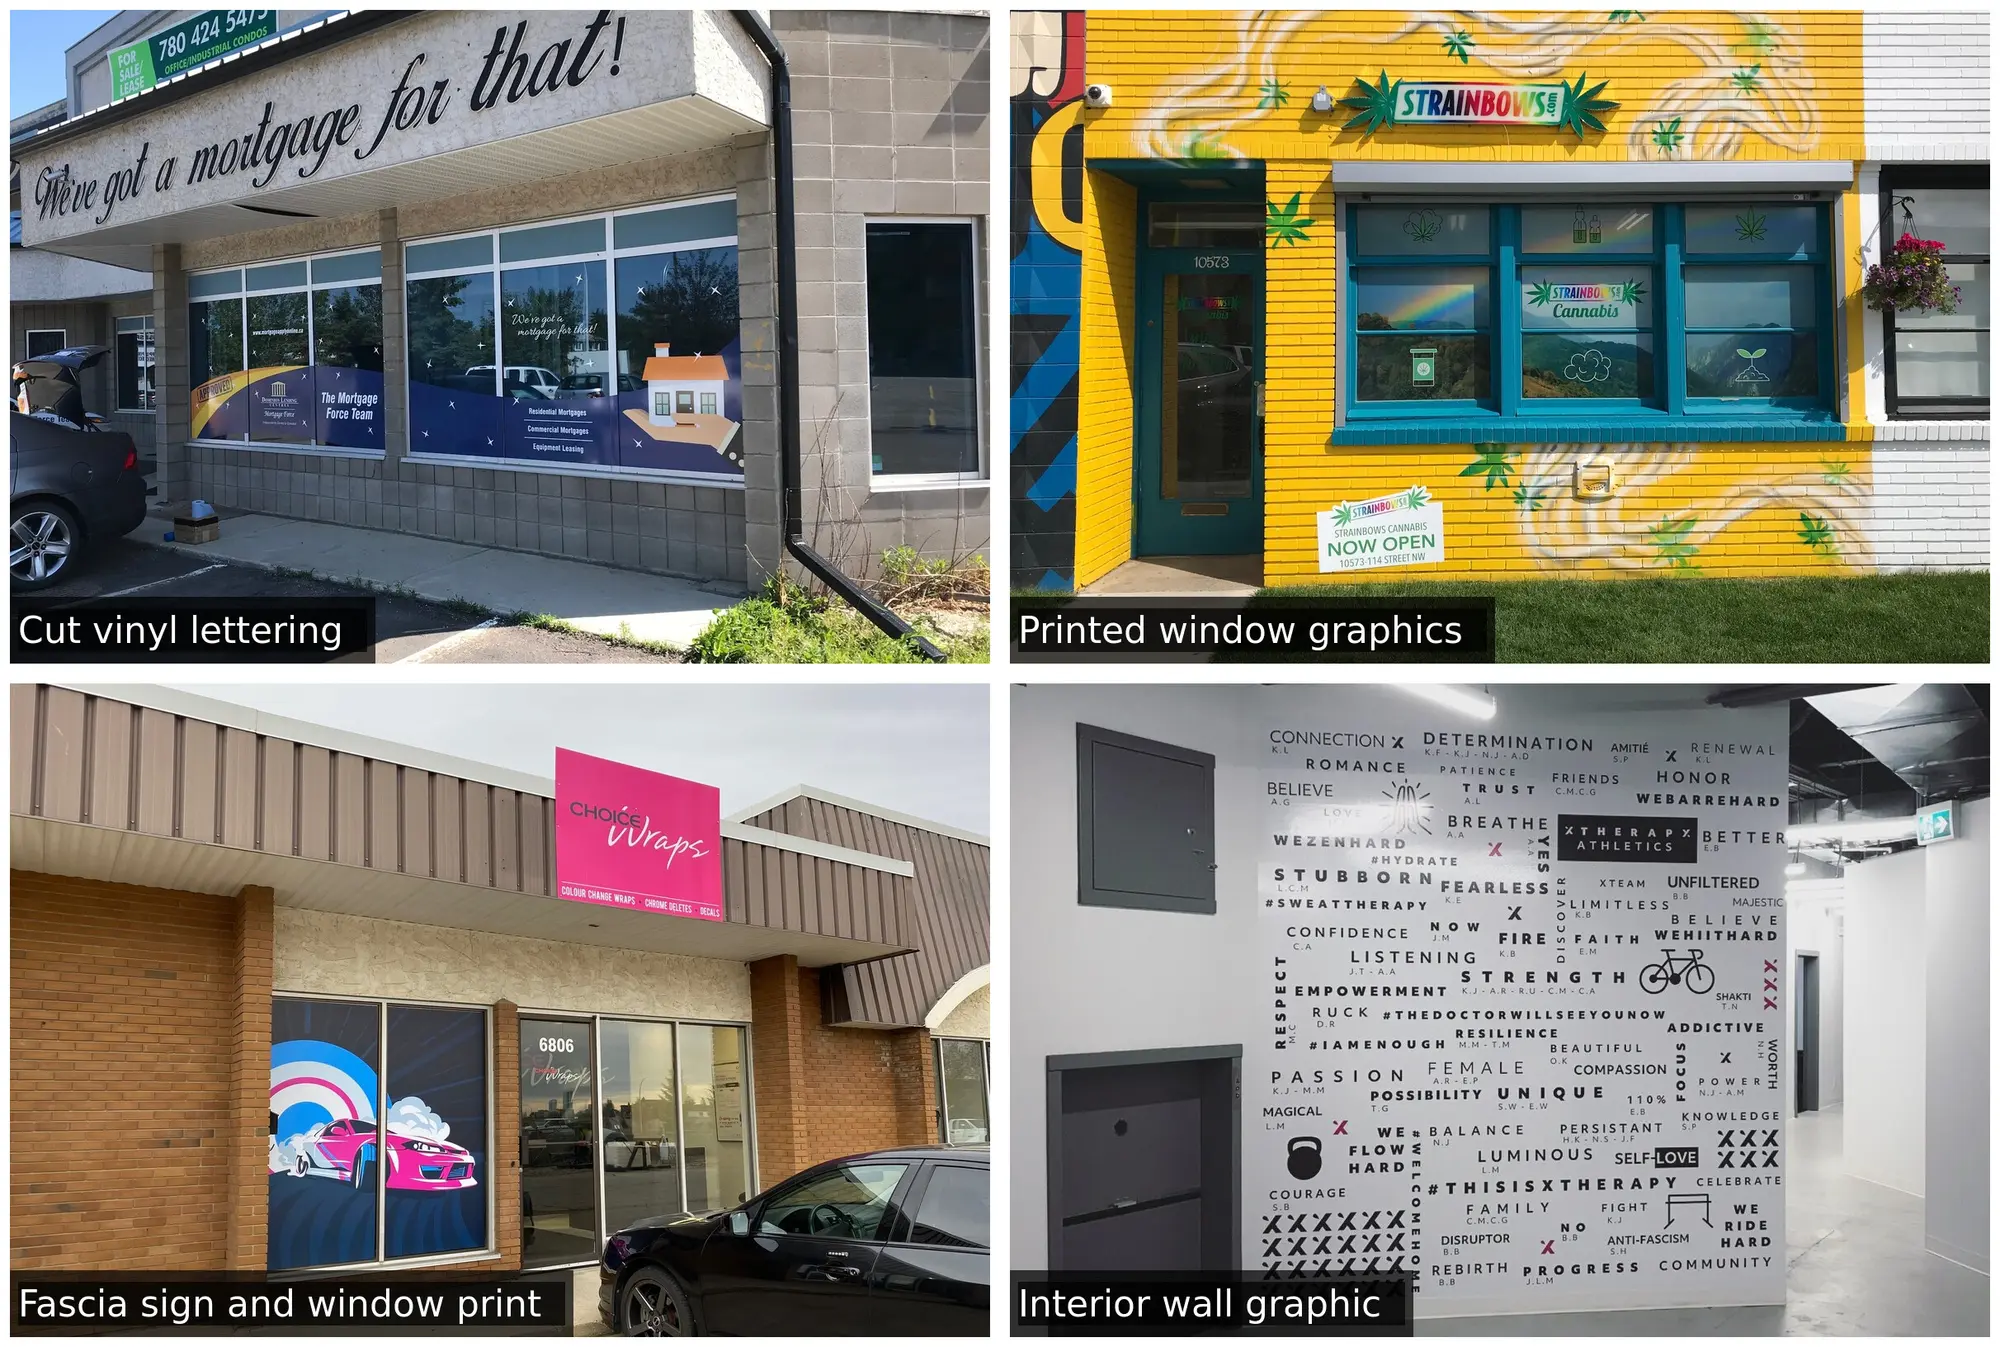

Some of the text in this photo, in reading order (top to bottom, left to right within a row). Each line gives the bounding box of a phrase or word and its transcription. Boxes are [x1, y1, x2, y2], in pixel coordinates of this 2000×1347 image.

[158, 31, 186, 62] 780
[191, 15, 220, 46] 424
[164, 26, 268, 75] OFFICE/INDUSTRIAL CONDOS
[118, 50, 137, 69] FOR
[119, 60, 144, 83] SALE/
[119, 76, 145, 97] LEASE
[1402, 88, 1546, 118] STRAINBOWS
[95, 142, 149, 224] got
[156, 157, 178, 193] a
[187, 101, 362, 188] mortgage
[354, 52, 450, 160] for
[470, 10, 626, 112] that!
[1194, 256, 1230, 268] 10573
[1553, 303, 1618, 318] Cannabis
[512, 313, 563, 328] We've got a
[517, 322, 598, 341] mortgage for that!
[199, 379, 231, 400] APPROVED
[321, 391, 378, 407] The Mortgage
[326, 407, 373, 420] Force Team
[528, 407, 587, 417] Residential Mortgages
[527, 425, 589, 435] Commercial Mortgages
[532, 443, 584, 454] Equipment Leasing
[1334, 521, 1428, 539] STRAINBOWS CANNABIS
[1328, 534, 1436, 557] NOW OPEN
[1340, 552, 1426, 568] 10573-114 STREET NW
[1269, 729, 1385, 748] CONNECTION
[1423, 731, 1594, 752] DETERMINATION
[1611, 742, 1649, 753] AMITIÉ
[1692, 743, 1775, 755] RENEWAL
[1306, 758, 1405, 773] ROMANCE
[1440, 766, 1515, 776] PATIENCE
[1553, 773, 1618, 784] FRIENDS
[1657, 771, 1730, 784] HONOR
[1268, 782, 1333, 797] BELIEVE
[1463, 783, 1534, 794] TRUST
[1637, 793, 1779, 807] WEBARREHARD
[570, 801, 641, 828] CHOICE
[1448, 815, 1547, 830] BREATHE
[608, 807, 710, 870] Wraps
[1274, 835, 1405, 849] WEZENHARD
[1703, 831, 1784, 844] BETTER
[1577, 840, 1673, 852] ATHLETICS
[1538, 836, 1549, 872] YES
[1371, 856, 1457, 866] #HYDRATE
[1275, 868, 1431, 884] STUBBORN
[1441, 881, 1548, 894] FEARLESS
[1600, 879, 1645, 887] XTEAM
[1668, 876, 1759, 889] UNFILTERED
[561, 885, 720, 918] COLOUR CHANGE WRAPS CHROME DELETES DECALS
[1266, 899, 1427, 910] #SWEATTHERAPY
[1570, 900, 1668, 910] LIMITLESS
[1733, 898, 1783, 907] MAJESTIC
[1557, 878, 1565, 963] DISCOVER
[1672, 914, 1777, 925] BELIEVE
[1287, 927, 1408, 939] CONFIDENCE
[1431, 922, 1480, 932] NOW
[1499, 933, 1545, 945] FIRE
[1575, 935, 1638, 944] FAITH
[1351, 951, 1475, 964] LISTENING
[1461, 971, 1624, 983] STRENGTH
[1295, 986, 1446, 996] EMPOWERMENT
[1716, 993, 1751, 1001] SHAKTI
[1275, 957, 1286, 1049] RESPECT
[1313, 1007, 1368, 1017] RUCK
[1383, 1011, 1665, 1020] #THEDOCTORWILLSEEYOUNOW
[1456, 1029, 1557, 1038] RESILIENCE
[1667, 1023, 1763, 1033] ADDICTIVE
[539, 1037, 574, 1053] 6806
[1309, 1040, 1444, 1050] #IAMENOUGH
[1551, 1044, 1642, 1053] BEAUTIFUL
[1429, 1061, 1523, 1075] FEMALE
[1574, 1064, 1666, 1075] COMPASSION
[1768, 1039, 1778, 1089] WORTH
[1272, 1069, 1402, 1084] PASSION
[1676, 1043, 1686, 1101] FOCUS
[1699, 1078, 1760, 1086] POWER
[1371, 1090, 1482, 1101] POSSIBILITY
[1498, 1087, 1603, 1101] UNIQUE
[1628, 1095, 1666, 1104] 110%
[1263, 1106, 1322, 1117] MAGICAL
[1682, 1112, 1779, 1121] KNOWLEDGE
[1377, 1127, 1404, 1138] WE
[1430, 1125, 1523, 1136] BALANCE
[1561, 1123, 1662, 1134] PERSISTANT
[1349, 1144, 1404, 1156] FLOW
[1478, 1148, 1592, 1162] LUMINOUS
[1614, 1150, 1698, 1167] SELF-LOVE
[1349, 1162, 1404, 1174] HARD
[1428, 1176, 1679, 1195] #THISISXTHERAPY
[1697, 1176, 1781, 1186] CELEBRATE
[1269, 1188, 1345, 1200] COURAGE
[1467, 1202, 1549, 1215] FAMILY
[1602, 1203, 1647, 1212] FIGHT
[1733, 1204, 1758, 1214] WE
[1561, 1223, 1586, 1232] NO
[1725, 1220, 1767, 1231] RIDE
[1441, 1234, 1510, 1245] DISRUPTOR
[1607, 1234, 1689, 1245] ANTI-FASCISM
[1721, 1237, 1771, 1248] HARD
[1432, 1262, 1507, 1276] REBIRTH
[1523, 1262, 1638, 1277] PROGRESS
[1659, 1257, 1771, 1271] COMMUNITY
